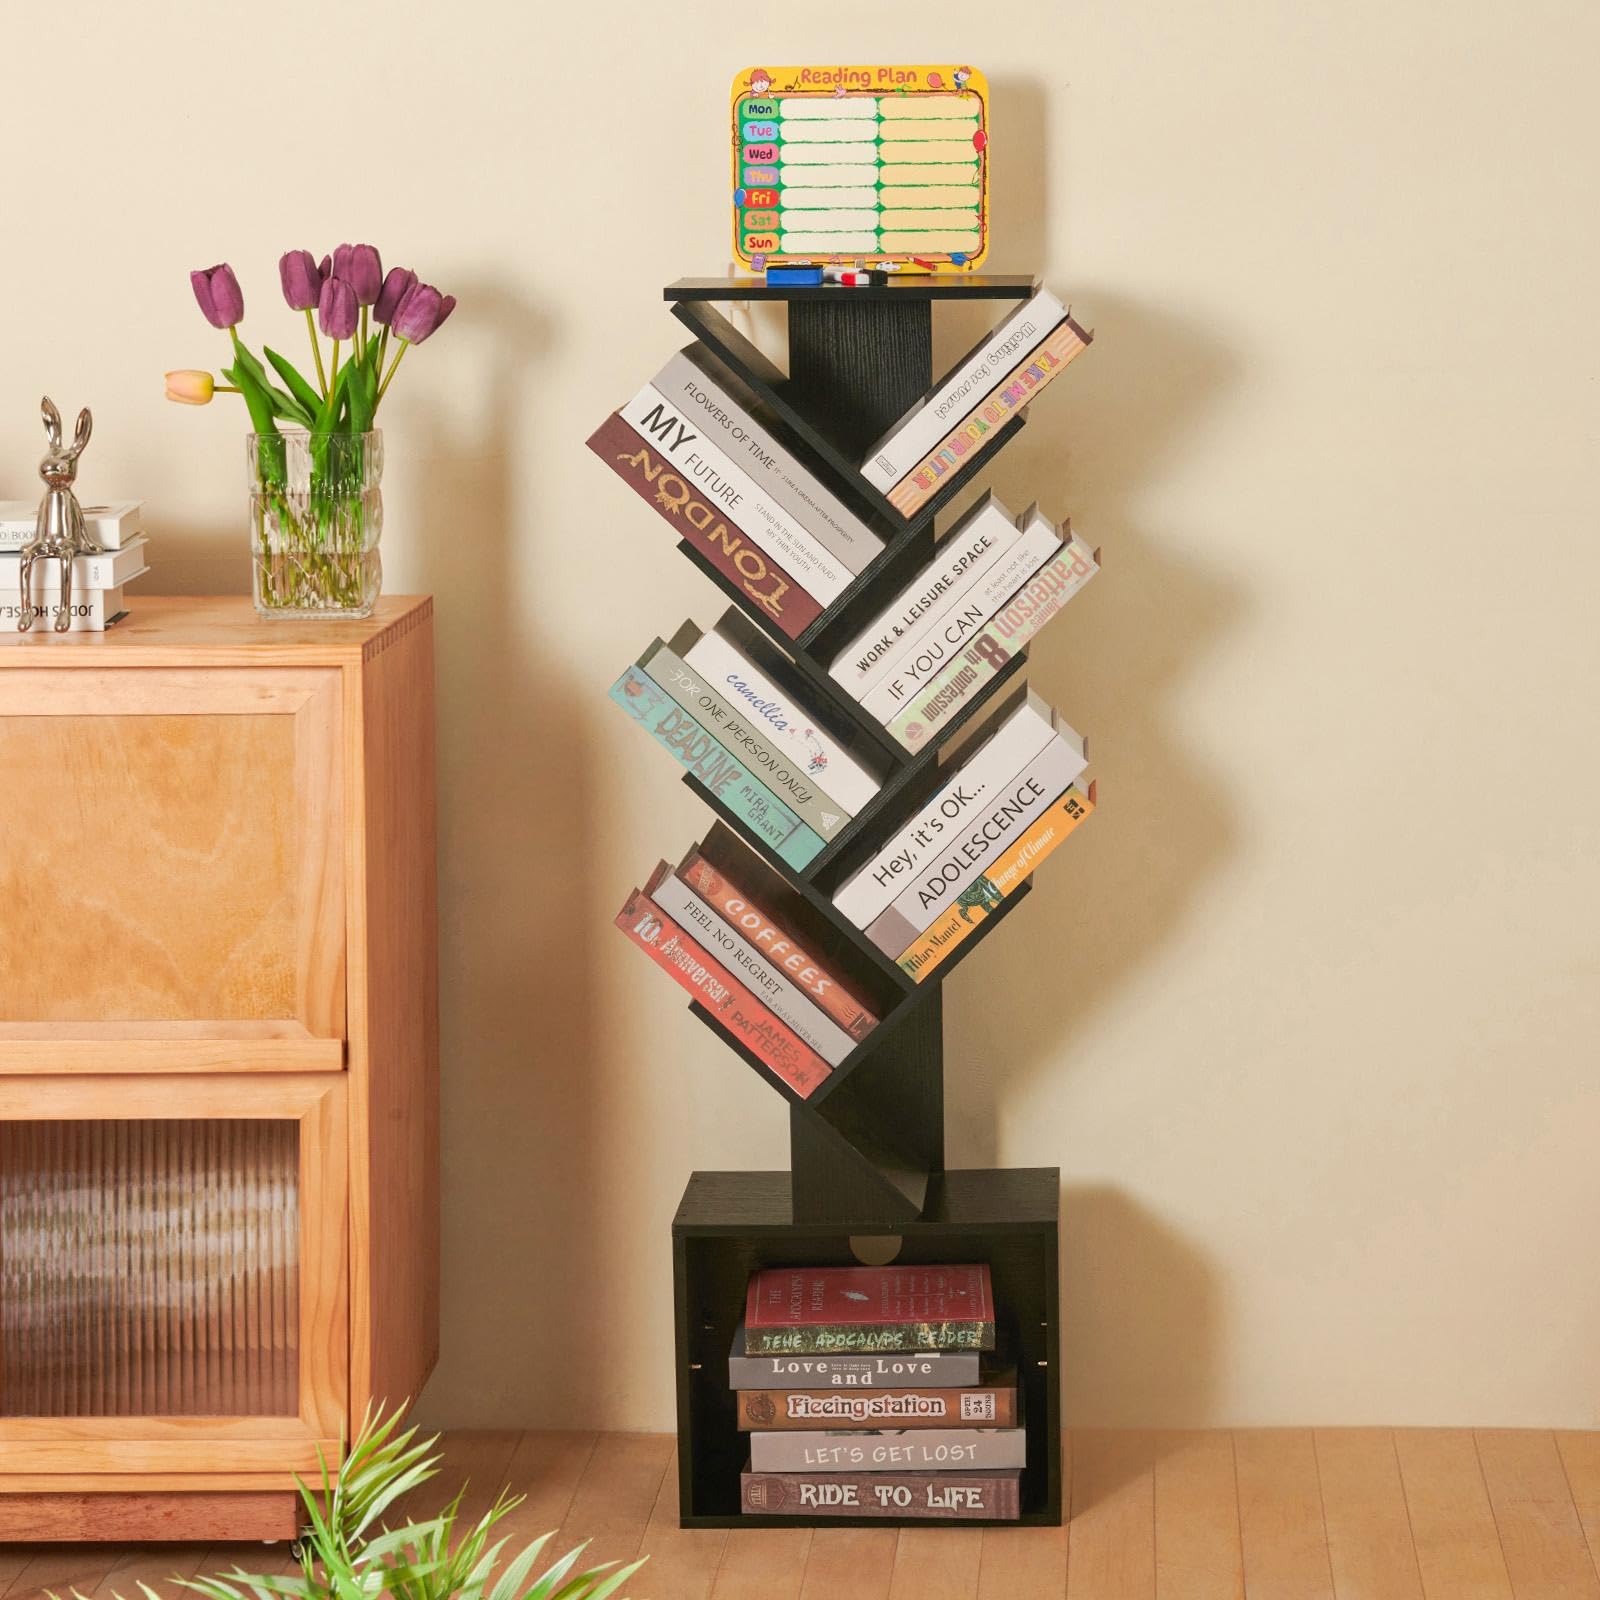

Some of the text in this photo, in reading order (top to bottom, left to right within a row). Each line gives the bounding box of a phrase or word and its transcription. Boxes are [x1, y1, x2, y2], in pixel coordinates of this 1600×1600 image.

[801, 68, 917, 87] Reading Plan
[749, 104, 772, 114] Mon
[750, 125, 772, 136] Tue
[749, 148, 772, 159] Wed
[750, 171, 773, 183] Thu
[751, 191, 771, 204] Fri
[751, 214, 772, 226] Sat
[749, 237, 772, 248] Sun
[934, 321, 1037, 420] Waiting for sunset
[1019, 350, 1061, 389] TAKE
[983, 401, 1009, 424] TO
[999, 380, 1028, 409] ME
[684, 382, 734, 429] FLOWERS
[732, 427, 750, 443] OF
[748, 441, 776, 469] TIME
[947, 417, 991, 457] YOUR
[640, 403, 743, 510] MY FUTURE
[911, 448, 957, 490] LITER
[616, 449, 790, 618] LONDON
[754, 503, 775, 524] STAND
[774, 520, 783, 530] IN
[780, 527, 794, 542] THE
[791, 538, 807, 553] SUN
[804, 549, 819, 565] AND
[856, 536, 992, 671] WORK & LEISURE SPACE
[993, 547, 1091, 639] Patterson
[888, 605, 983, 700] IF YOU CAN
[726, 675, 788, 731] camellia
[920, 665, 979, 722] confession
[653, 707, 743, 798] DEADLINE
[699, 696, 727, 722] ONE
[723, 721, 779, 771] PERSON
[777, 770, 812, 804] ONLY
[739, 785, 769, 815] MIRA
[746, 808, 785, 840] GRANT
[872, 785, 985, 887] Hey, it's OK...
[918, 777, 1045, 910] ADOLESCENCE
[904, 948, 934, 973] Hilary
[929, 918, 961, 946] Mantel
[988, 863, 1018, 894] Change
[1022, 827, 1055, 859] Climate
[684, 901, 783, 995] FEEL NO REGRET
[725, 898, 833, 996] COFFEES
[731, 1011, 809, 1085] PATTERSON
[754, 1019, 802, 1063] JAMES
[917, 1330, 977, 1344] READER
[773, 1359, 828, 1373] Love
[877, 1359, 932, 1374] Love
[831, 1371, 873, 1385] and
[871, 1397, 943, 1414] station
[973, 1399, 983, 1415] 24
[804, 1444, 977, 1464] LET'S GET LOST
[800, 1484, 985, 1513] RIDE TO LIFE
